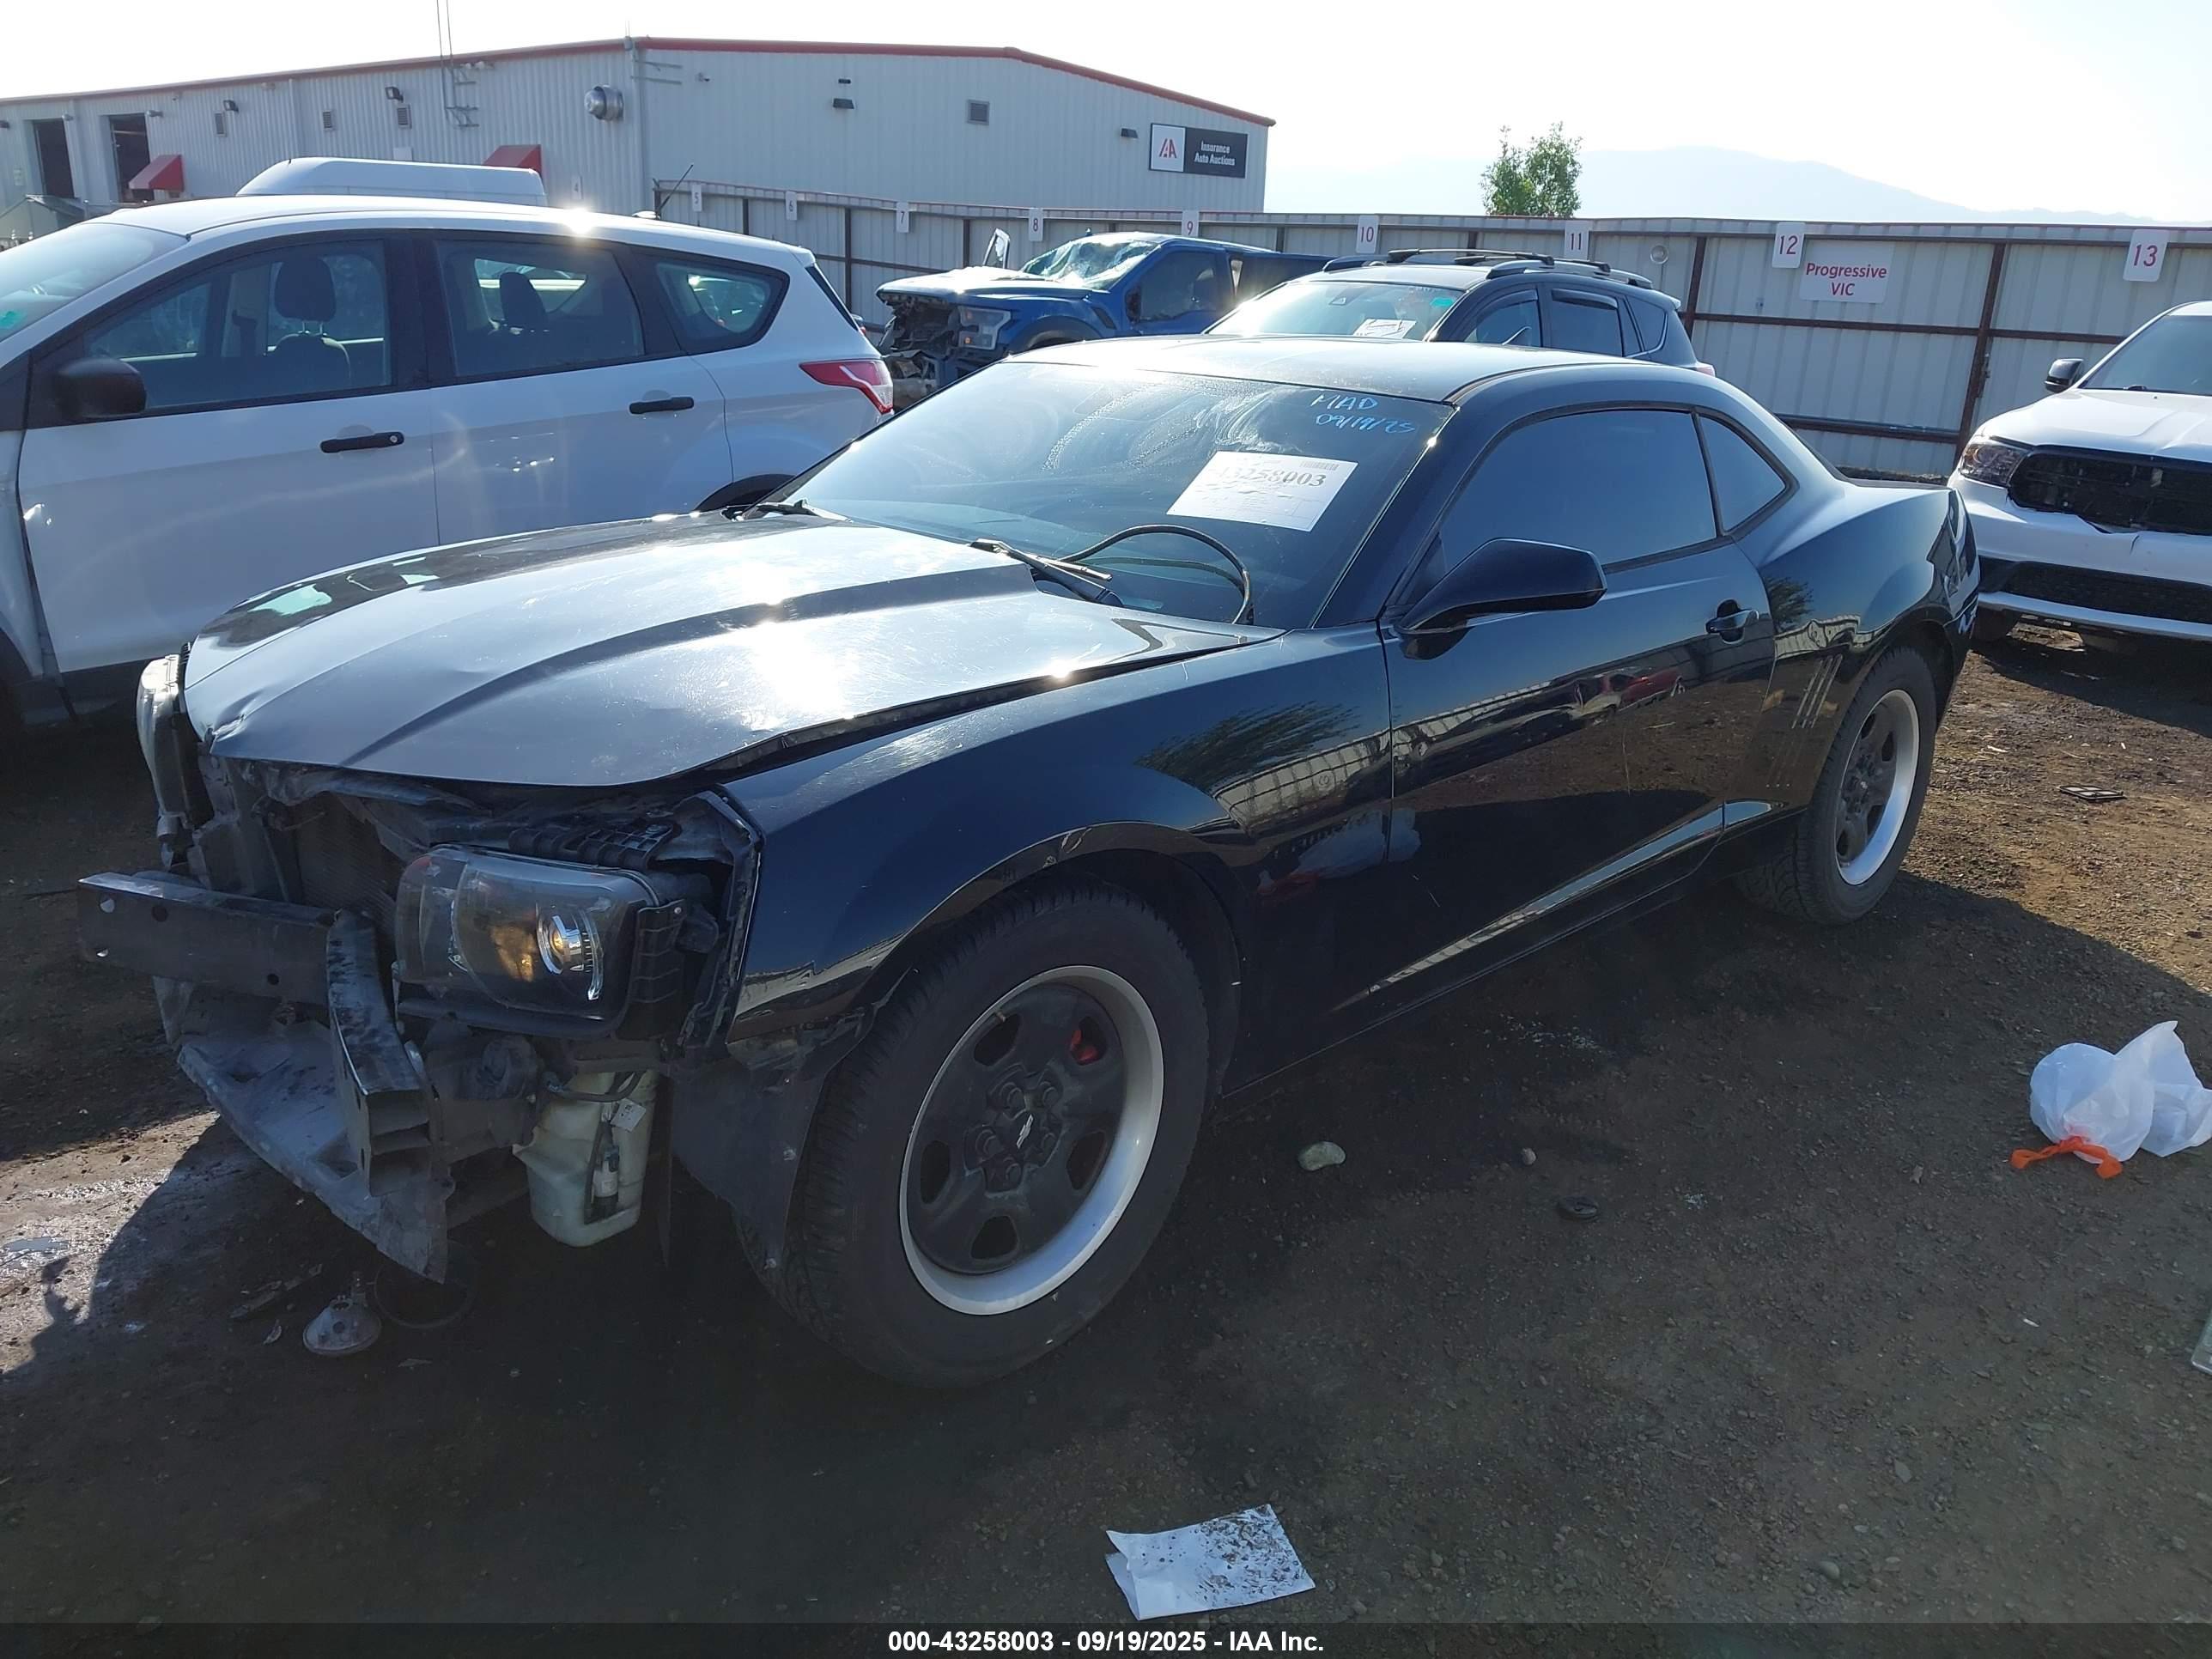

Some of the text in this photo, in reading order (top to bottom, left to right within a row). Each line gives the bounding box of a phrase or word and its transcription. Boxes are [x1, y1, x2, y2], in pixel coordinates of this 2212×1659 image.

[1200, 140, 1231, 154] Insurance
[1194, 152, 1236, 166] Auto Auctions
[900, 210, 905, 224] 7
[1033, 218, 1039, 232] 8
[1187, 220, 1194, 236] 9
[1359, 226, 1374, 243] 10
[1570, 232, 1583, 251] 11
[1779, 234, 1798, 255] 12
[2133, 244, 2158, 267] 13
[1806, 262, 1887, 279] Progressive
[1831, 282, 1856, 296] VIC
